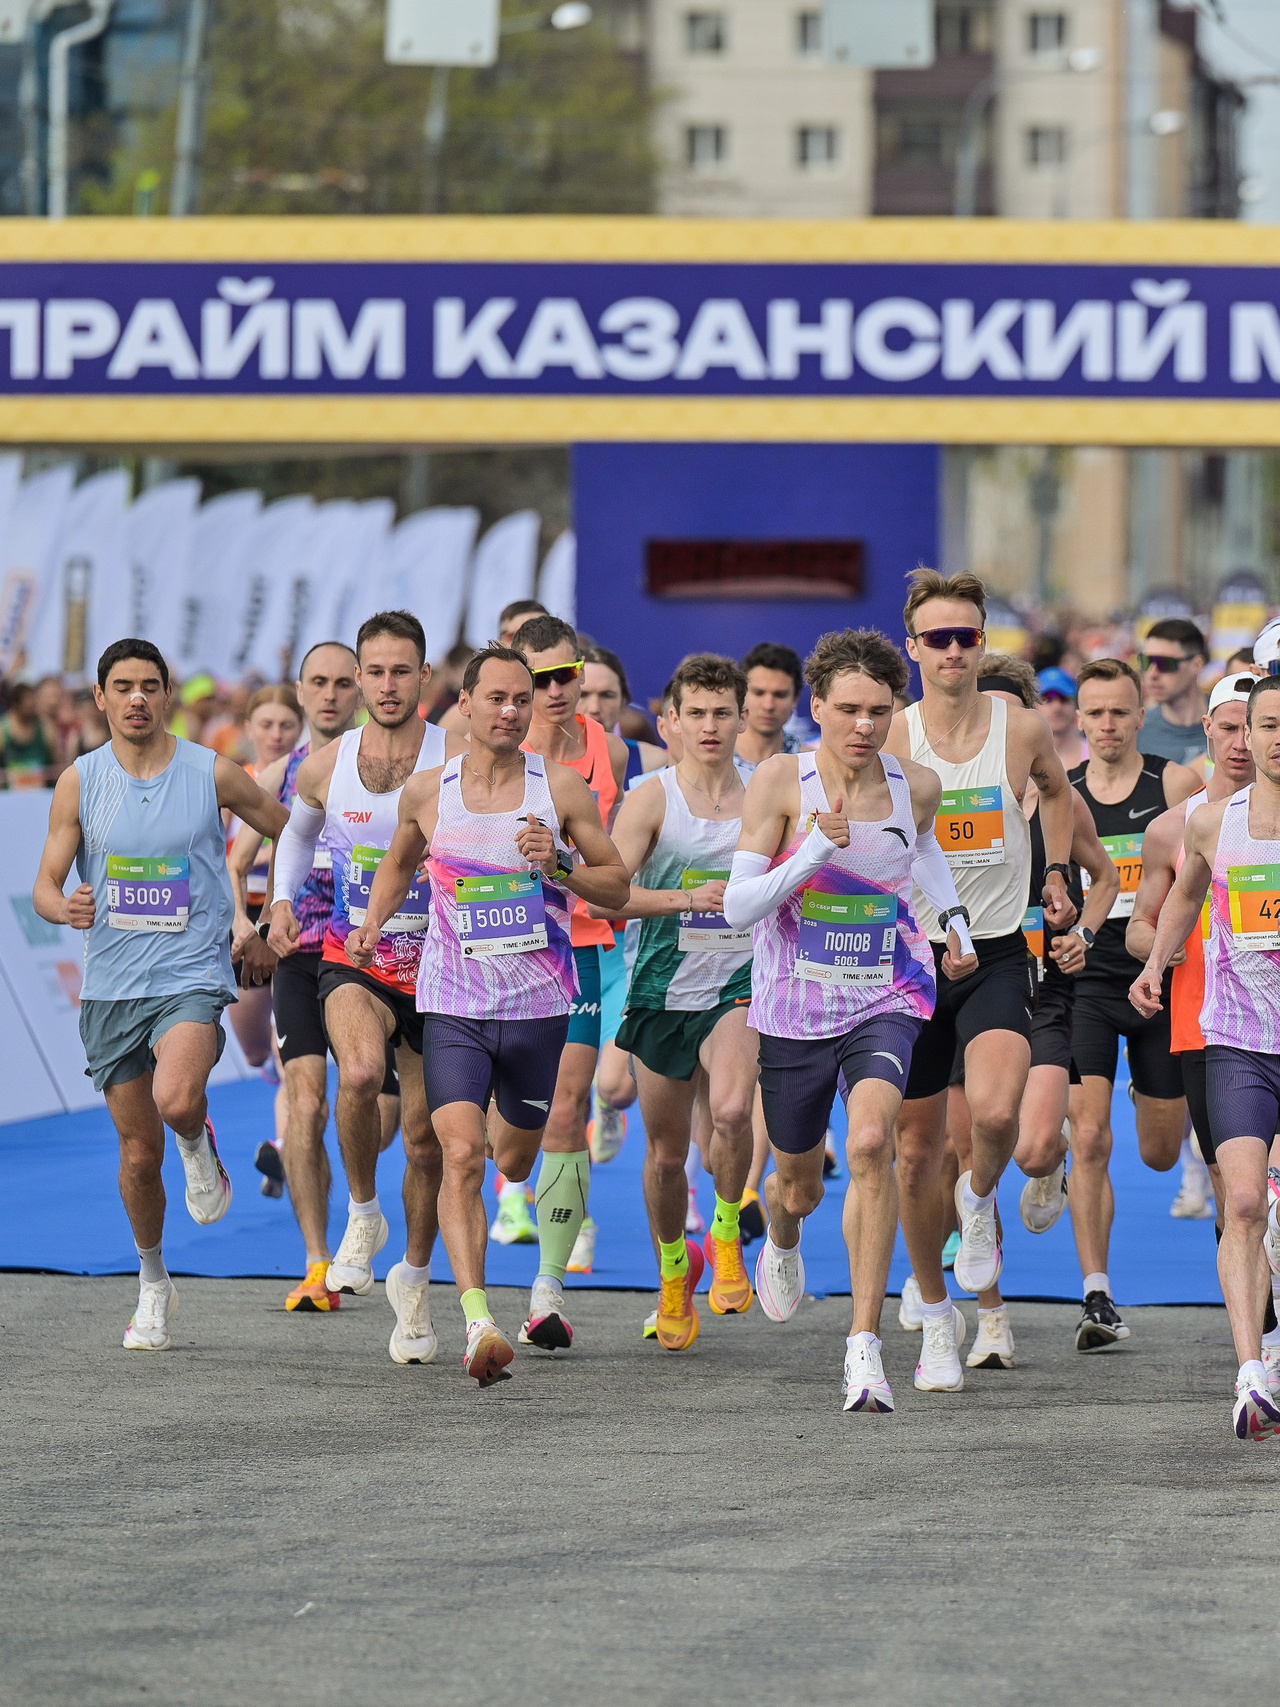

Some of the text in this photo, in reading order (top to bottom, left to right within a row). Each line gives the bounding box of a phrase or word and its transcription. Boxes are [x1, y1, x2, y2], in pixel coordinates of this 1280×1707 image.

[433, 278, 1207, 382] КАЗАНСКИЙ
[950, 821, 974, 840] 50
[125, 888, 172, 905] 5009
[476, 906, 528, 928] 5008
[824, 932, 871, 952] ПОПОВ
[834, 956, 859, 966] 5003
